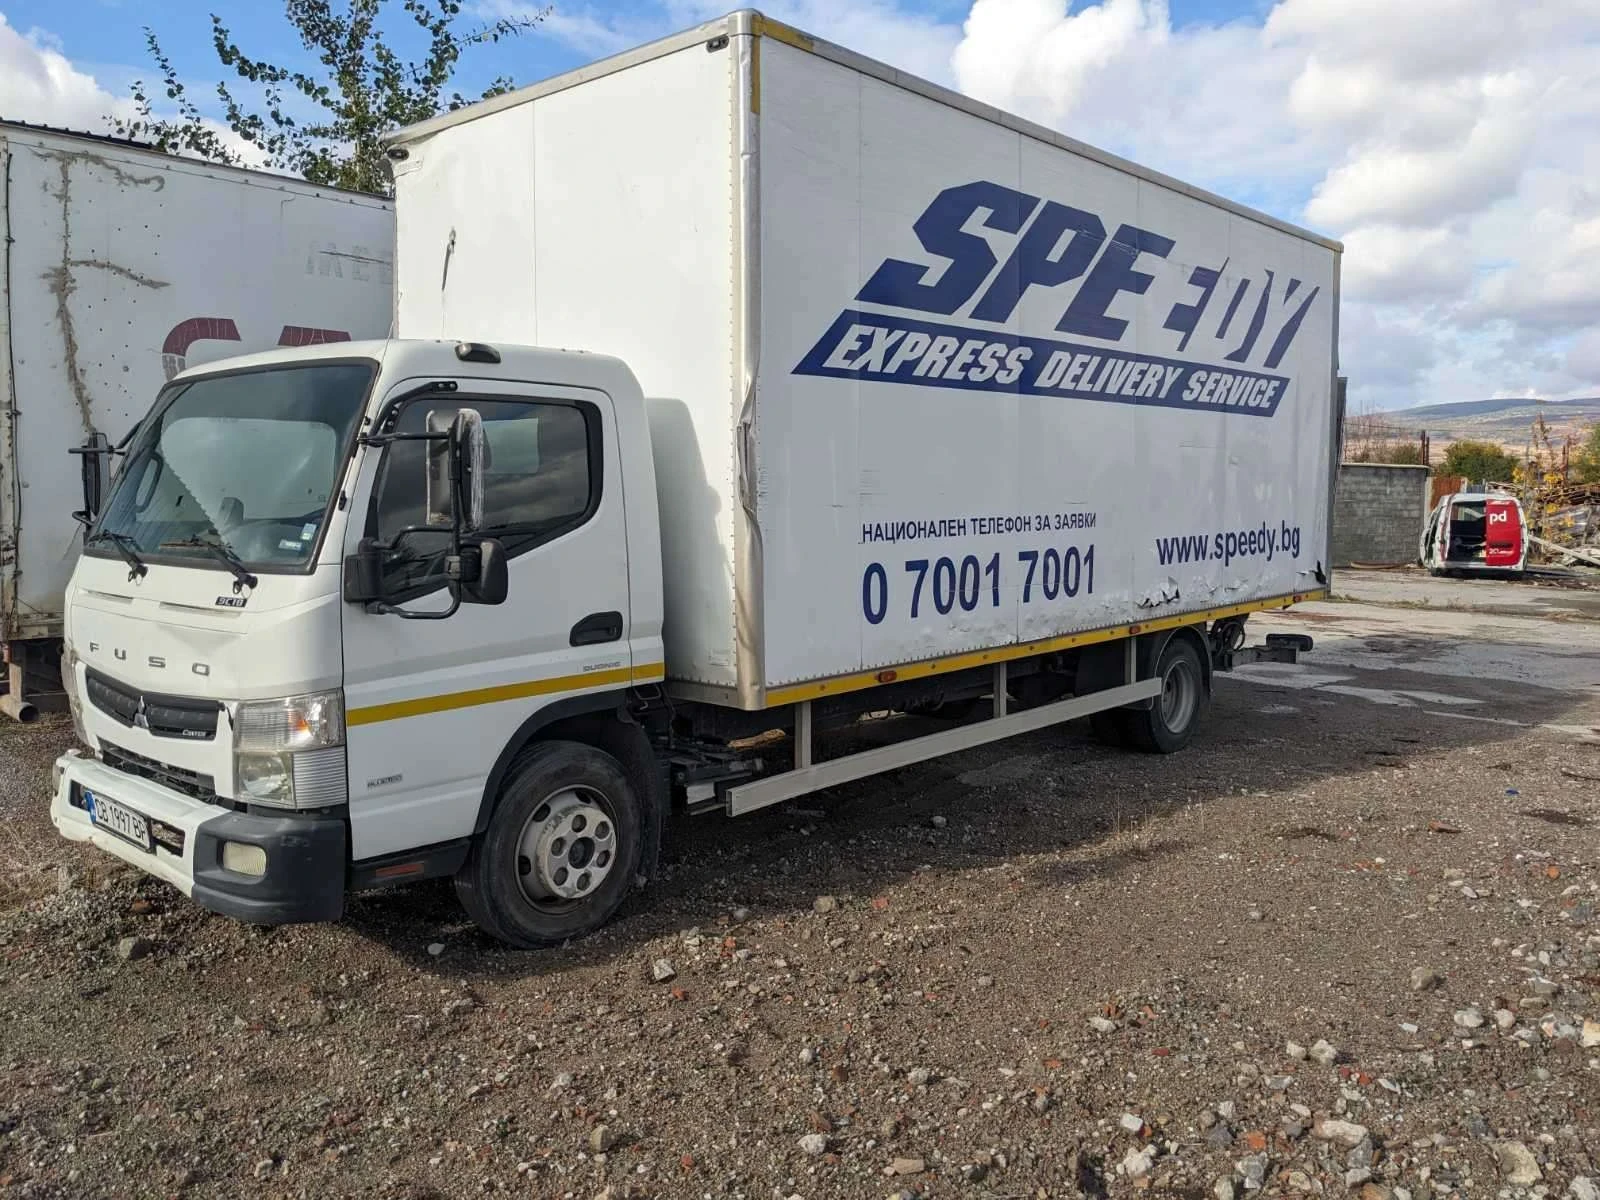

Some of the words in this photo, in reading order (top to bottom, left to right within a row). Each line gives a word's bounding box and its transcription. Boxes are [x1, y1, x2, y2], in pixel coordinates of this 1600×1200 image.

[854, 180, 1320, 370] SPEEDY
[822, 323, 1034, 385] EXPRESS
[1034, 349, 1182, 399] DELIVERY
[1182, 371, 1280, 409] SERVICE
[862, 515, 968, 544] НАЦИОНАЛЕН
[970, 514, 1031, 536] ТЕЛЕФОН
[1034, 513, 1052, 532] ЗА
[1054, 512, 1097, 531] ЗАЯВКИ
[1489, 511, 1507, 525] pd
[1155, 519, 1301, 567] www.speedy.bg
[863, 562, 888, 625] 0
[905, 552, 1000, 618] 7001
[1018, 544, 1095, 603] 7001
[89, 642, 211, 677] FUSO
[110, 806, 130, 833] 1997
